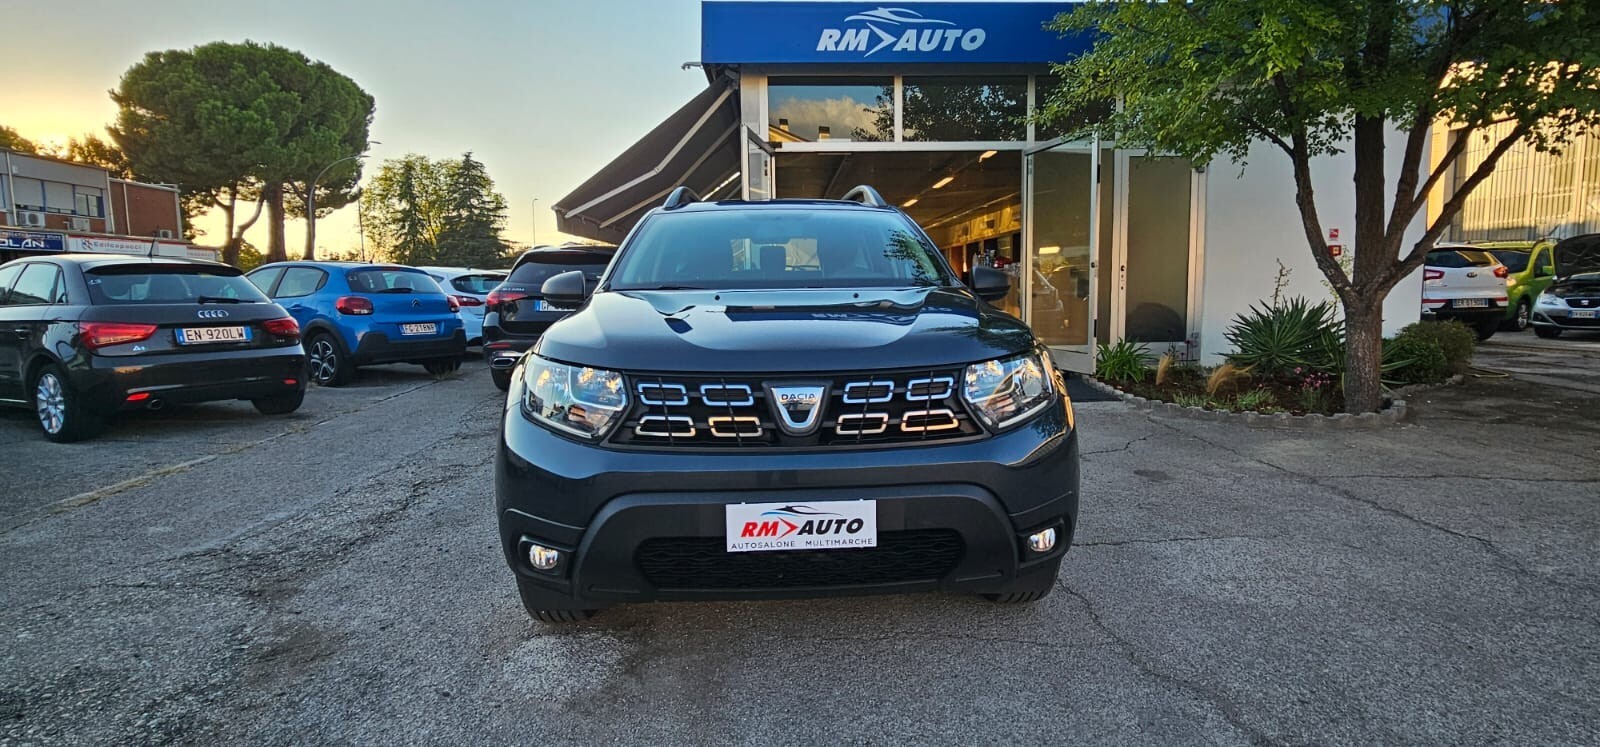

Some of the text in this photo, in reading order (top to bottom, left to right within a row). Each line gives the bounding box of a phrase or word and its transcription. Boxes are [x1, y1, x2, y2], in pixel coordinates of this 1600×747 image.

[816, 28, 986, 51] RM AUTO
[185, 328, 245, 341] EN 920LW
[781, 393, 816, 401] DACIA
[741, 518, 863, 537] RM AUTO
[731, 537, 873, 550] AUTOSALONE MULTIMARCHE
